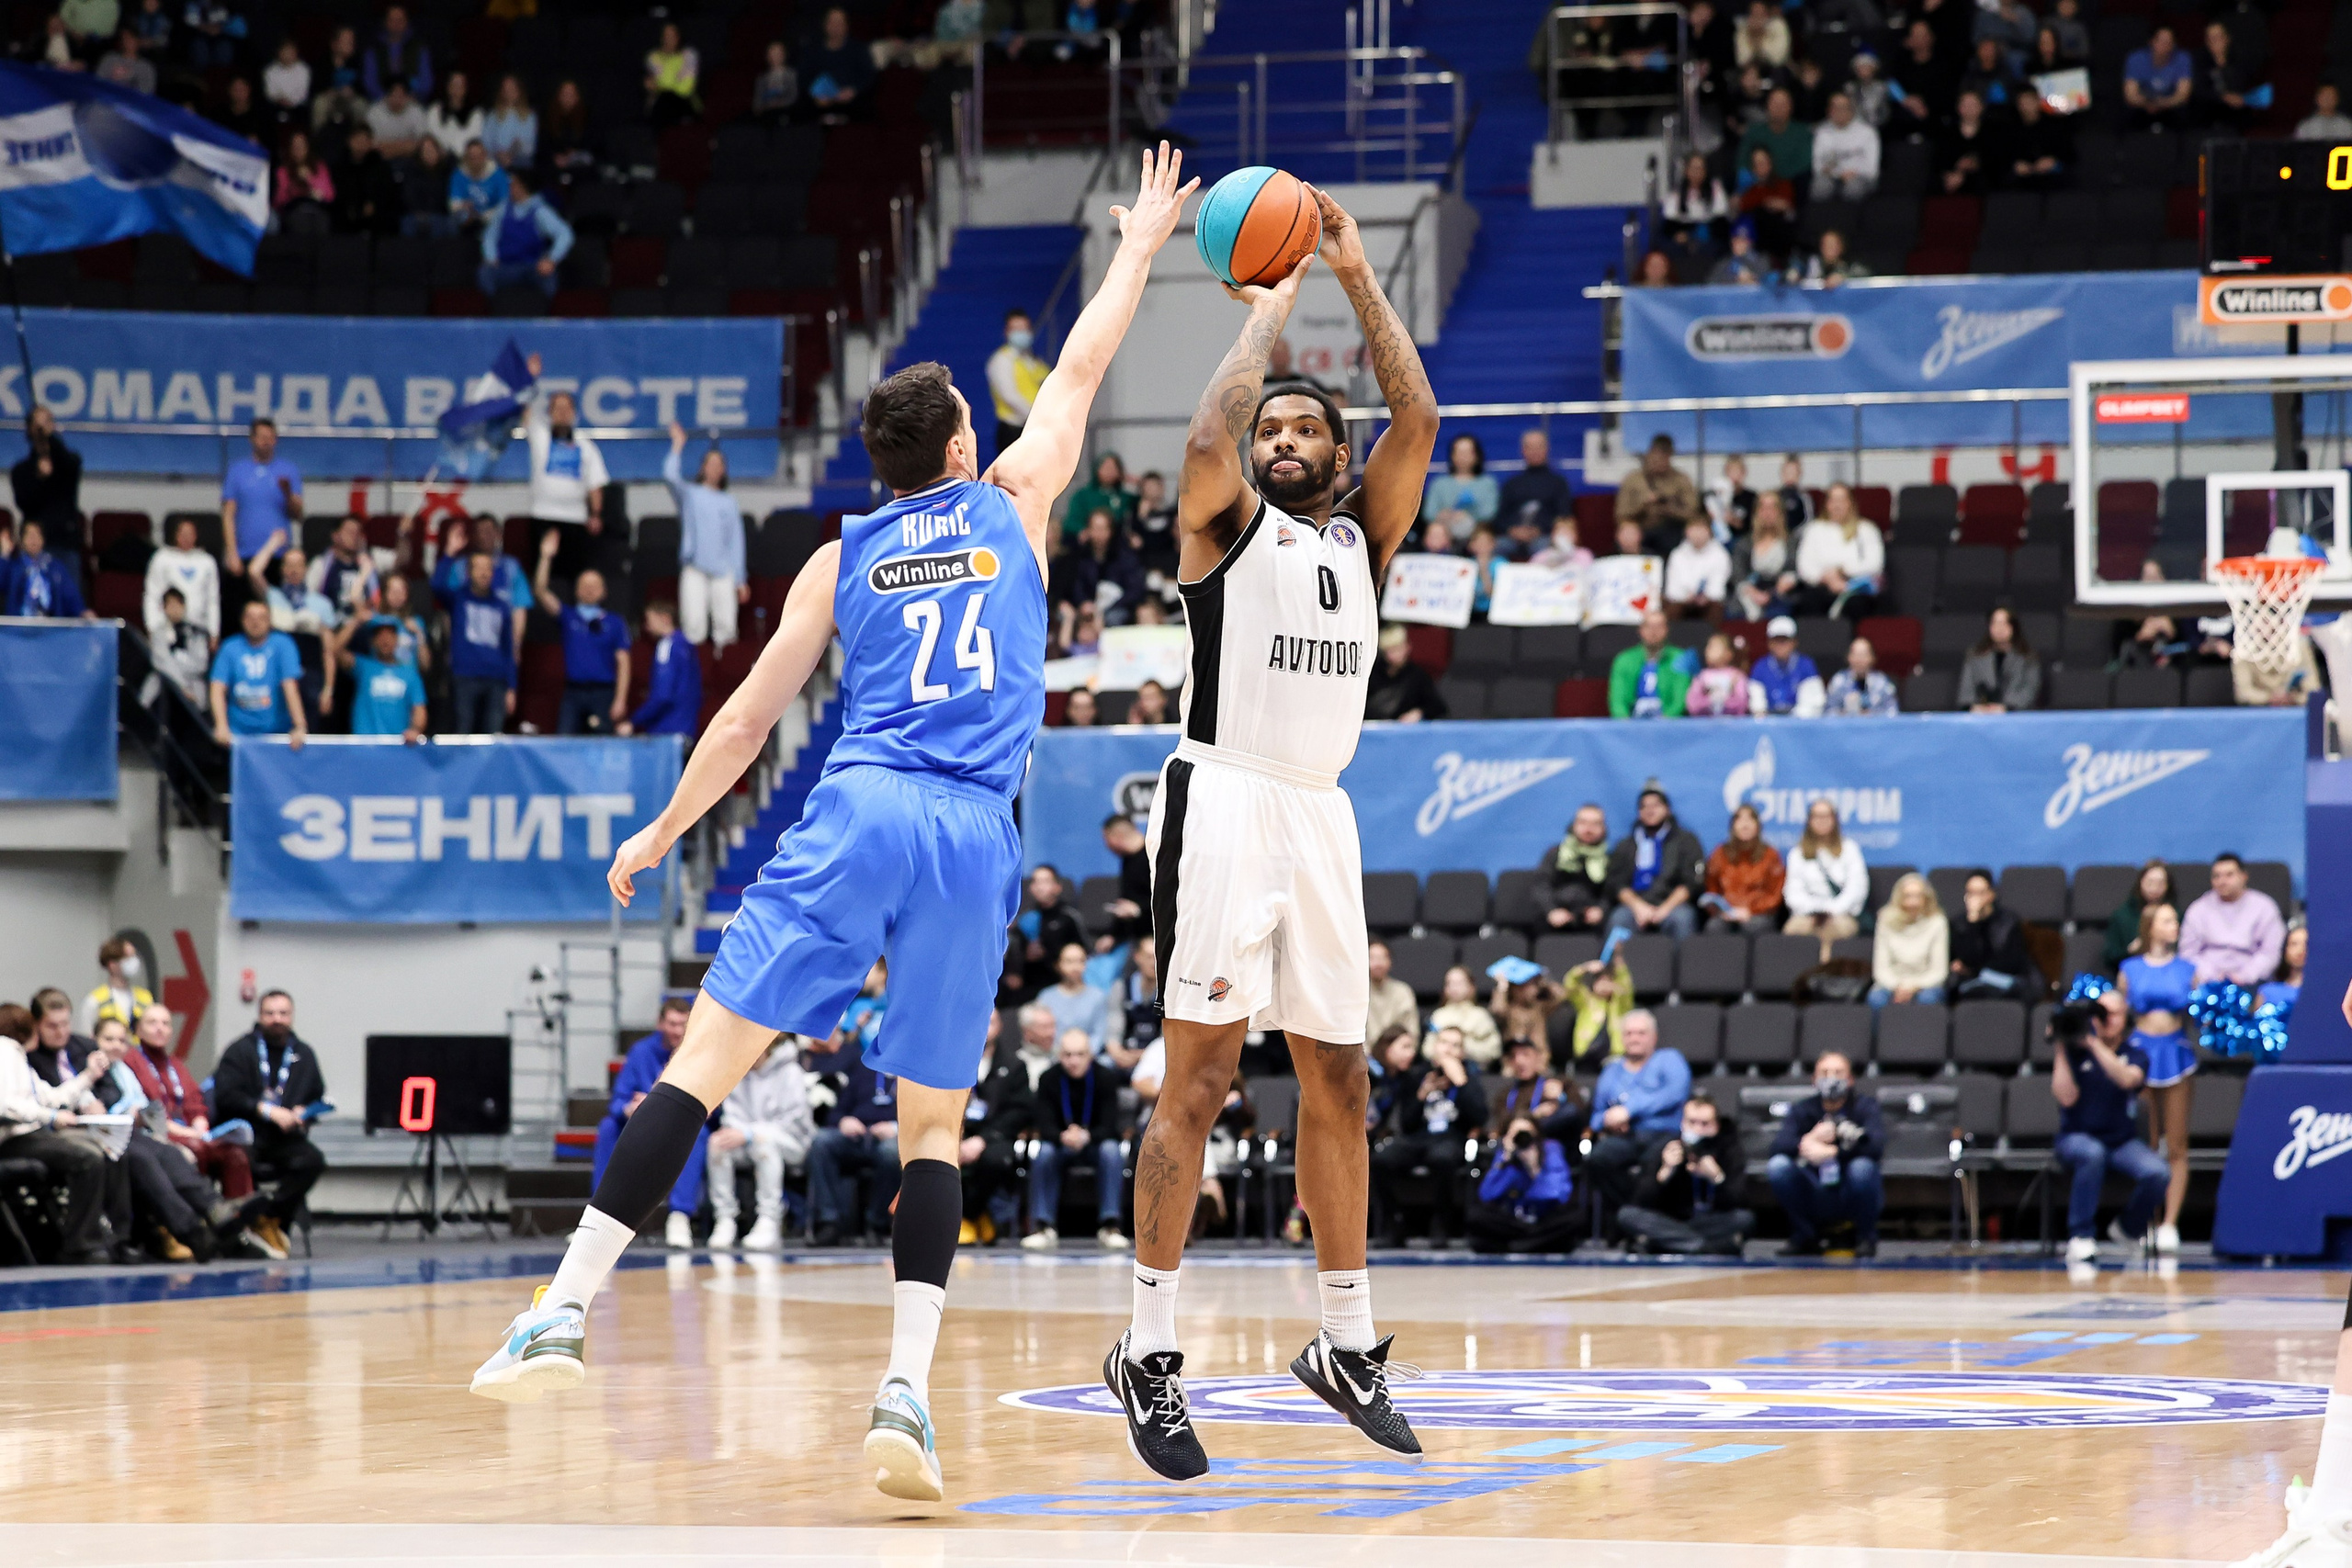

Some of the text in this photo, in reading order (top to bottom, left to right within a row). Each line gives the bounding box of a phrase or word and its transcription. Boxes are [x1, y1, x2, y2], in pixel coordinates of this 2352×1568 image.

[2326, 146, 2352, 191] 0
[2222, 288, 2318, 313] Winline
[404, 376, 749, 428] ВСТЕ
[878, 560, 966, 586] Winline
[1317, 564, 1341, 614] 0
[901, 592, 997, 705] 24
[1267, 634, 1363, 677] AVTODO
[1416, 750, 1577, 837] Зенит
[2043, 742, 2211, 829] Зенит
[278, 793, 636, 863] ЗЕНИТ
[399, 1076, 436, 1132] 0
